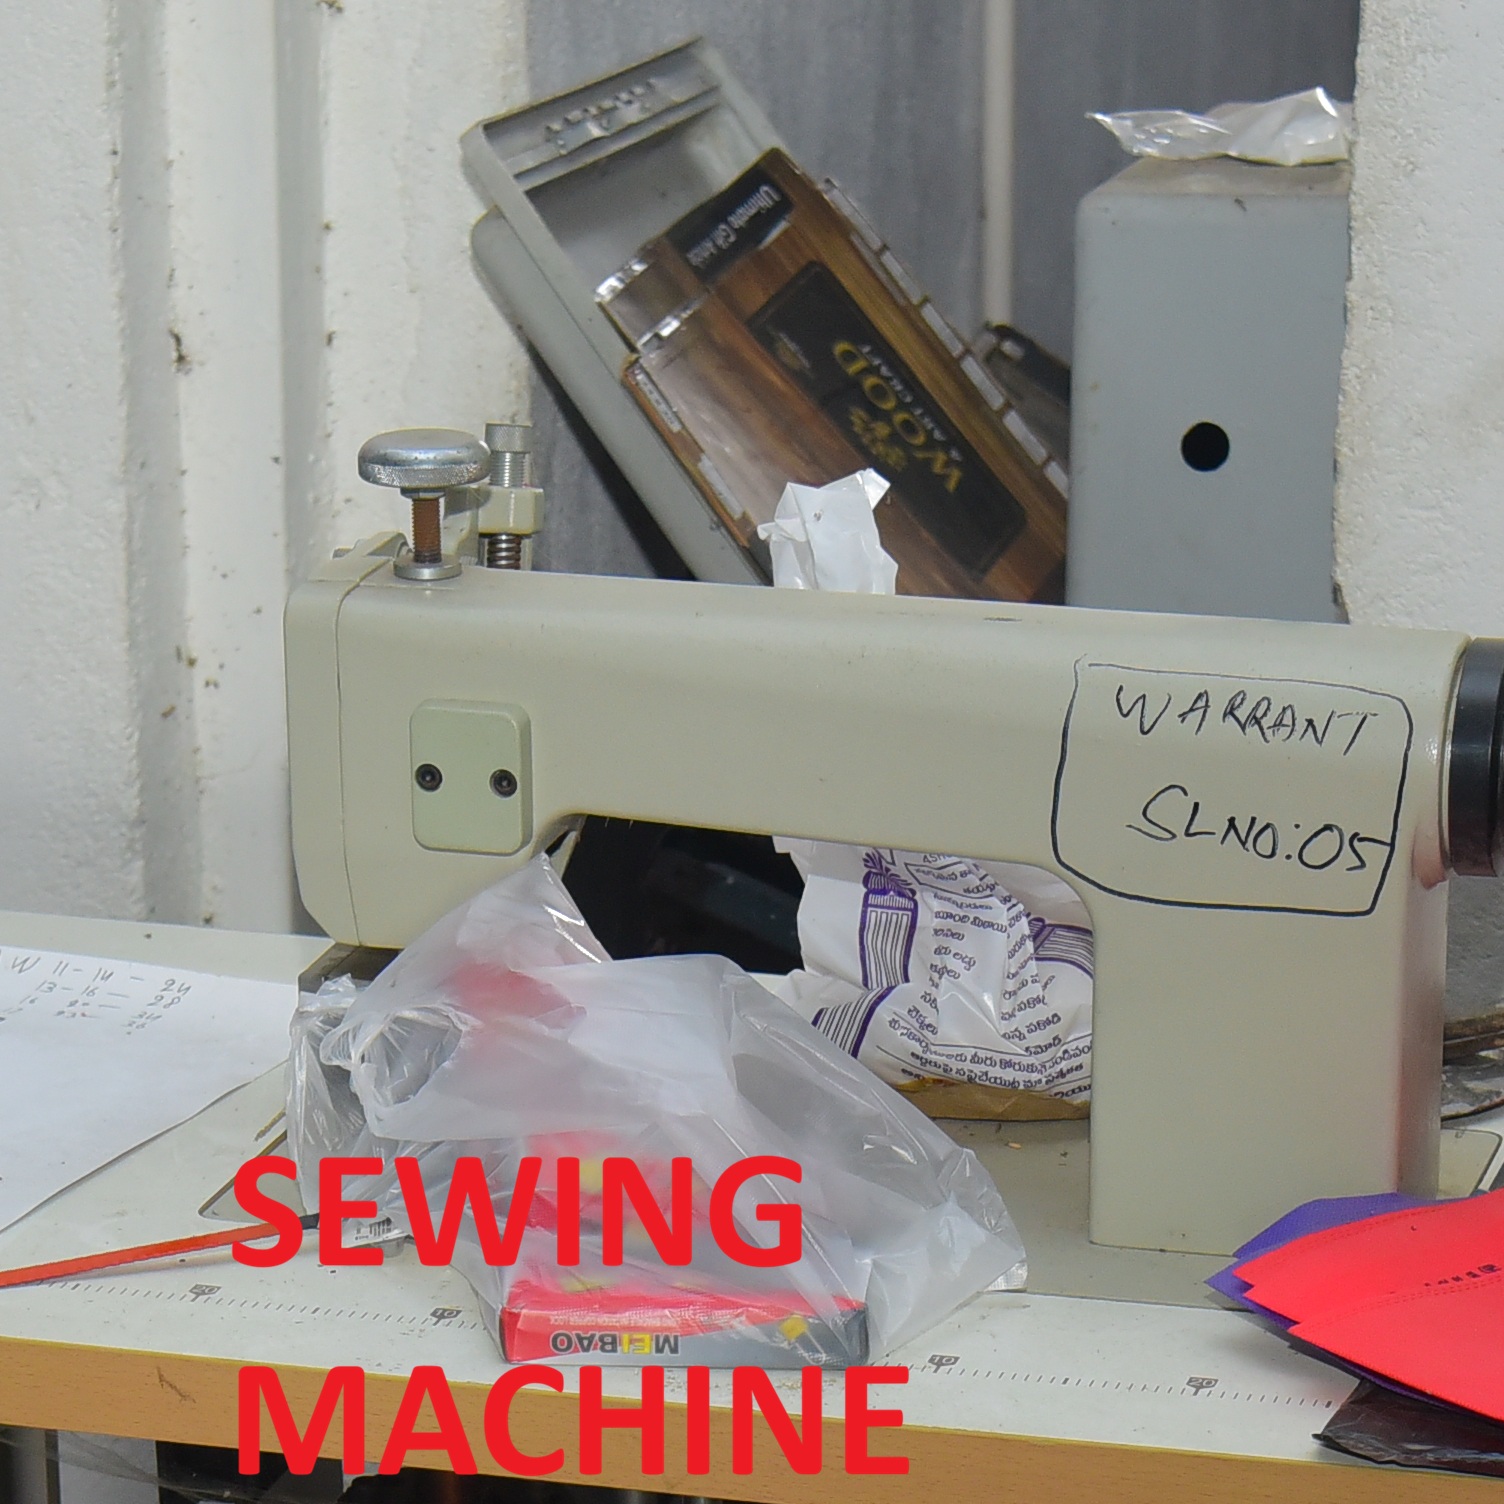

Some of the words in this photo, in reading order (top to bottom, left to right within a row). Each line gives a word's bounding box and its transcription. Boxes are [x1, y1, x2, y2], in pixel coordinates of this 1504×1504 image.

[832, 341, 960, 491] WOOD
[1114, 683, 1380, 757] WARRANT
[551, 1331, 679, 1355] MEIBAO
[1188, 1377, 1216, 1388] 20
